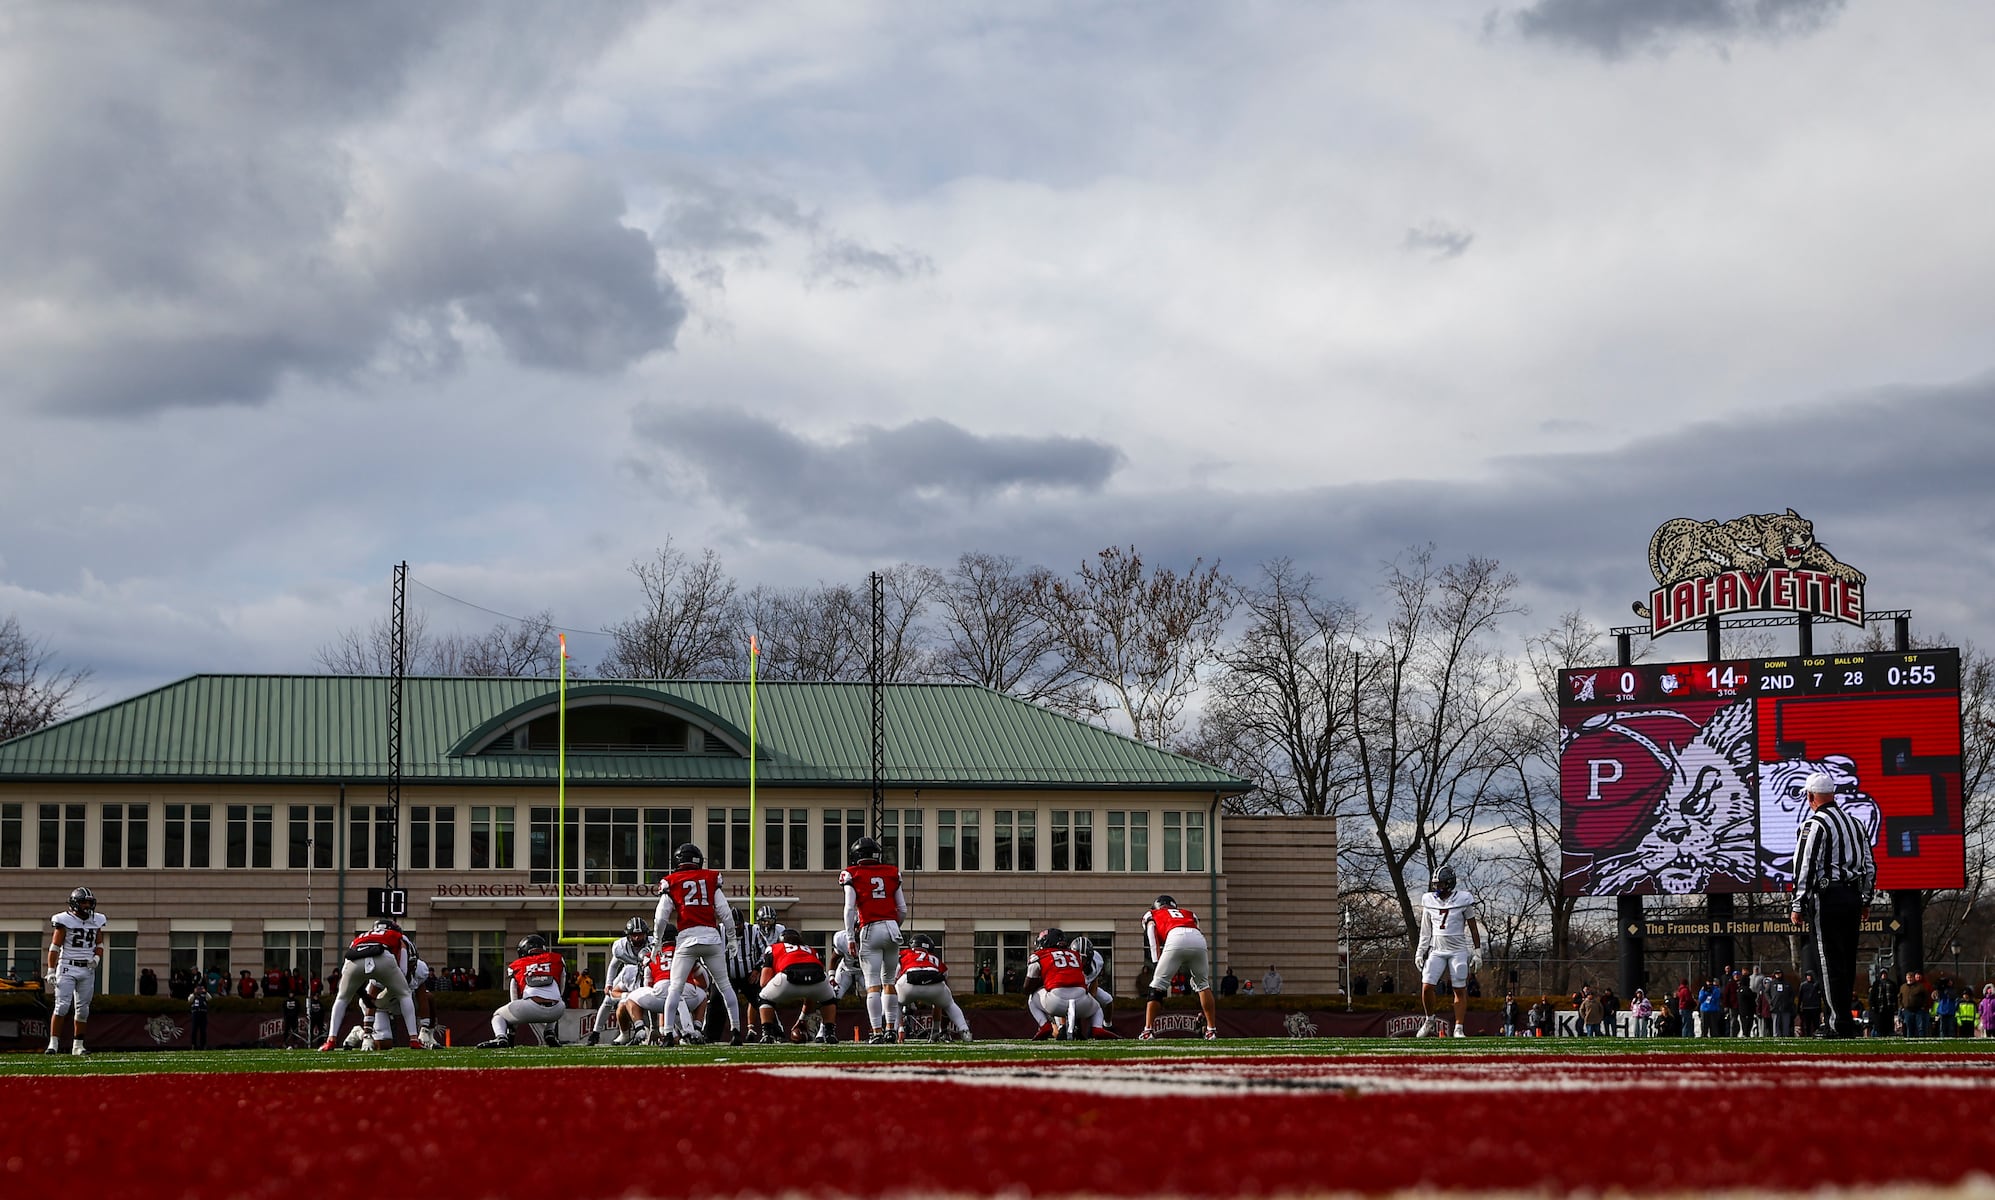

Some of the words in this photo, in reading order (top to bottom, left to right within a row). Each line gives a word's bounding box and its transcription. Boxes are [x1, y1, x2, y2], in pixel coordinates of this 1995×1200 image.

[1652, 567, 1864, 637] LAFAYETTE
[1764, 661, 1788, 669] DOWN
[1803, 659, 1813, 668] TO
[1814, 658, 1826, 667] GO
[1834, 657, 1851, 665] BALL
[1852, 656, 1864, 665] ON
[1903, 655, 1918, 663] 1ST
[1620, 671, 1636, 694] 0
[1706, 666, 1735, 689] 14
[1760, 674, 1795, 690] 2ND
[1813, 673, 1824, 688] 7
[1843, 671, 1864, 686] 28
[1887, 664, 1937, 686] 0:55
[1586, 758, 1624, 800] P
[437, 884, 526, 897] BOURGER
[538, 884, 614, 897] VARSITY
[682, 879, 710, 906] 21
[870, 877, 886, 899] 2
[381, 890, 405, 915] 10
[1439, 908, 1449, 930] 7
[1645, 922, 1665, 934] The
[1667, 922, 1711, 934] Frances
[1713, 922, 1724, 933] D.
[1727, 921, 1761, 933] Fisher
[71, 928, 95, 948] 24
[1051, 950, 1080, 968] 53
